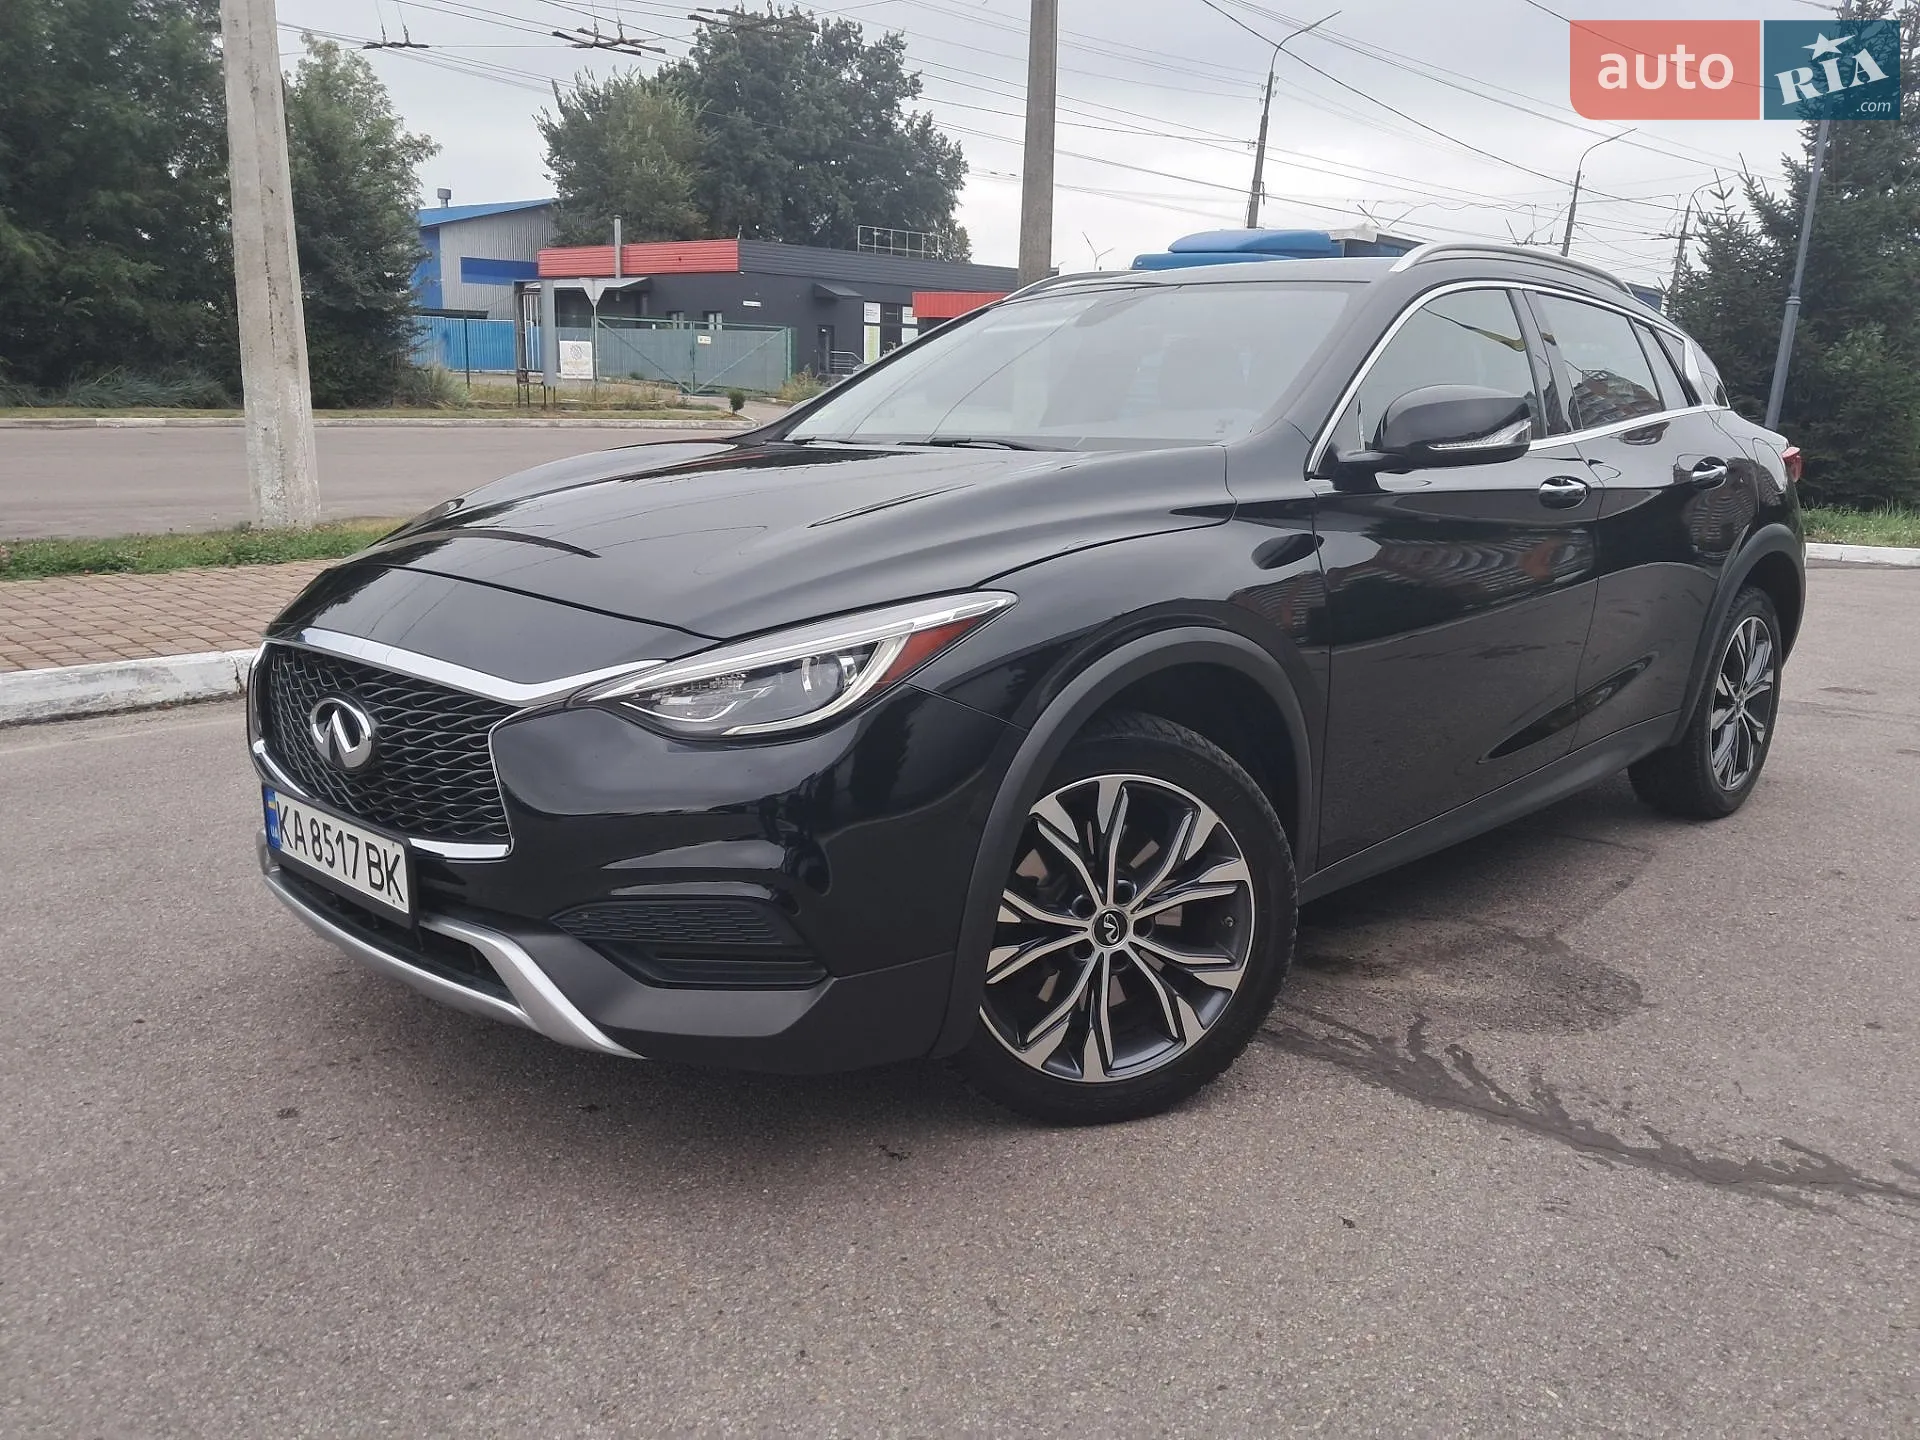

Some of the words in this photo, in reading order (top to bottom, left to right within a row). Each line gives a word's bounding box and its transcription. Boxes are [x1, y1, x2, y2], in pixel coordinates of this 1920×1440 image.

[277, 801, 309, 856] KA
[309, 817, 360, 880] 8517
[364, 841, 404, 903] BK
